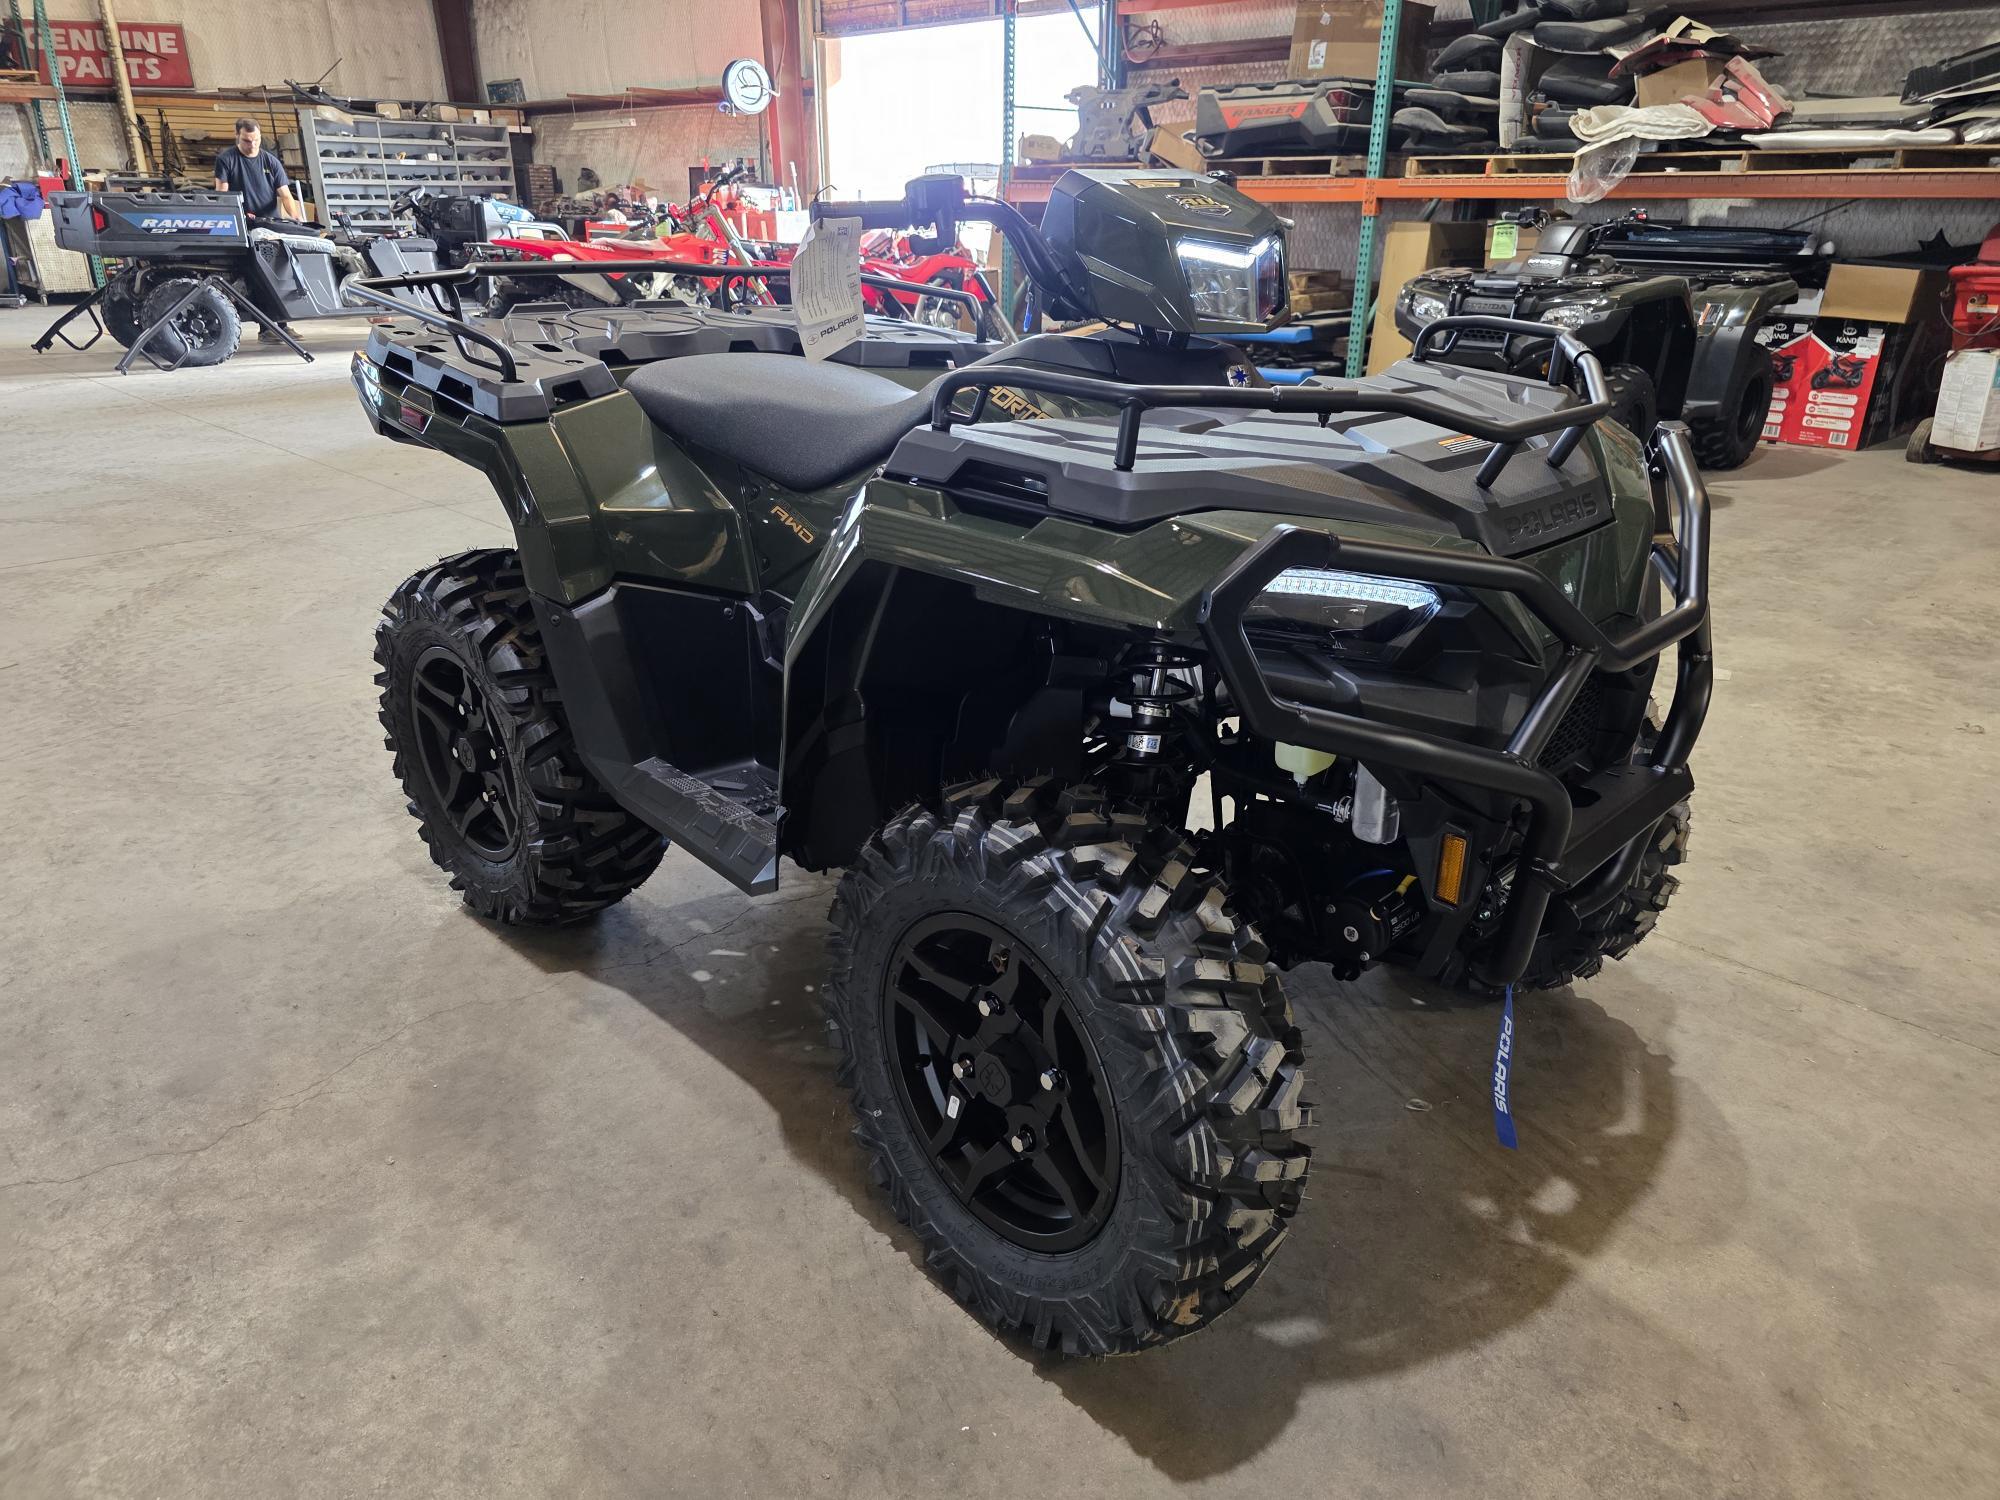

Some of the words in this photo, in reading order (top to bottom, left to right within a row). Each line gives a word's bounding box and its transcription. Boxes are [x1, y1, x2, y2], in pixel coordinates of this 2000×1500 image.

[1232, 105, 1297, 117] RANGER
[141, 218, 233, 229] RANGER
[579, 242, 615, 253] HONDA
[820, 313, 860, 338] POLARIS
[1773, 332, 1790, 340] ANDI
[1836, 335, 1858, 345] KAND
[1503, 492, 1598, 545] POLARIS
[770, 505, 816, 545] AWD
[1494, 1015, 1512, 1115] POLARIS
